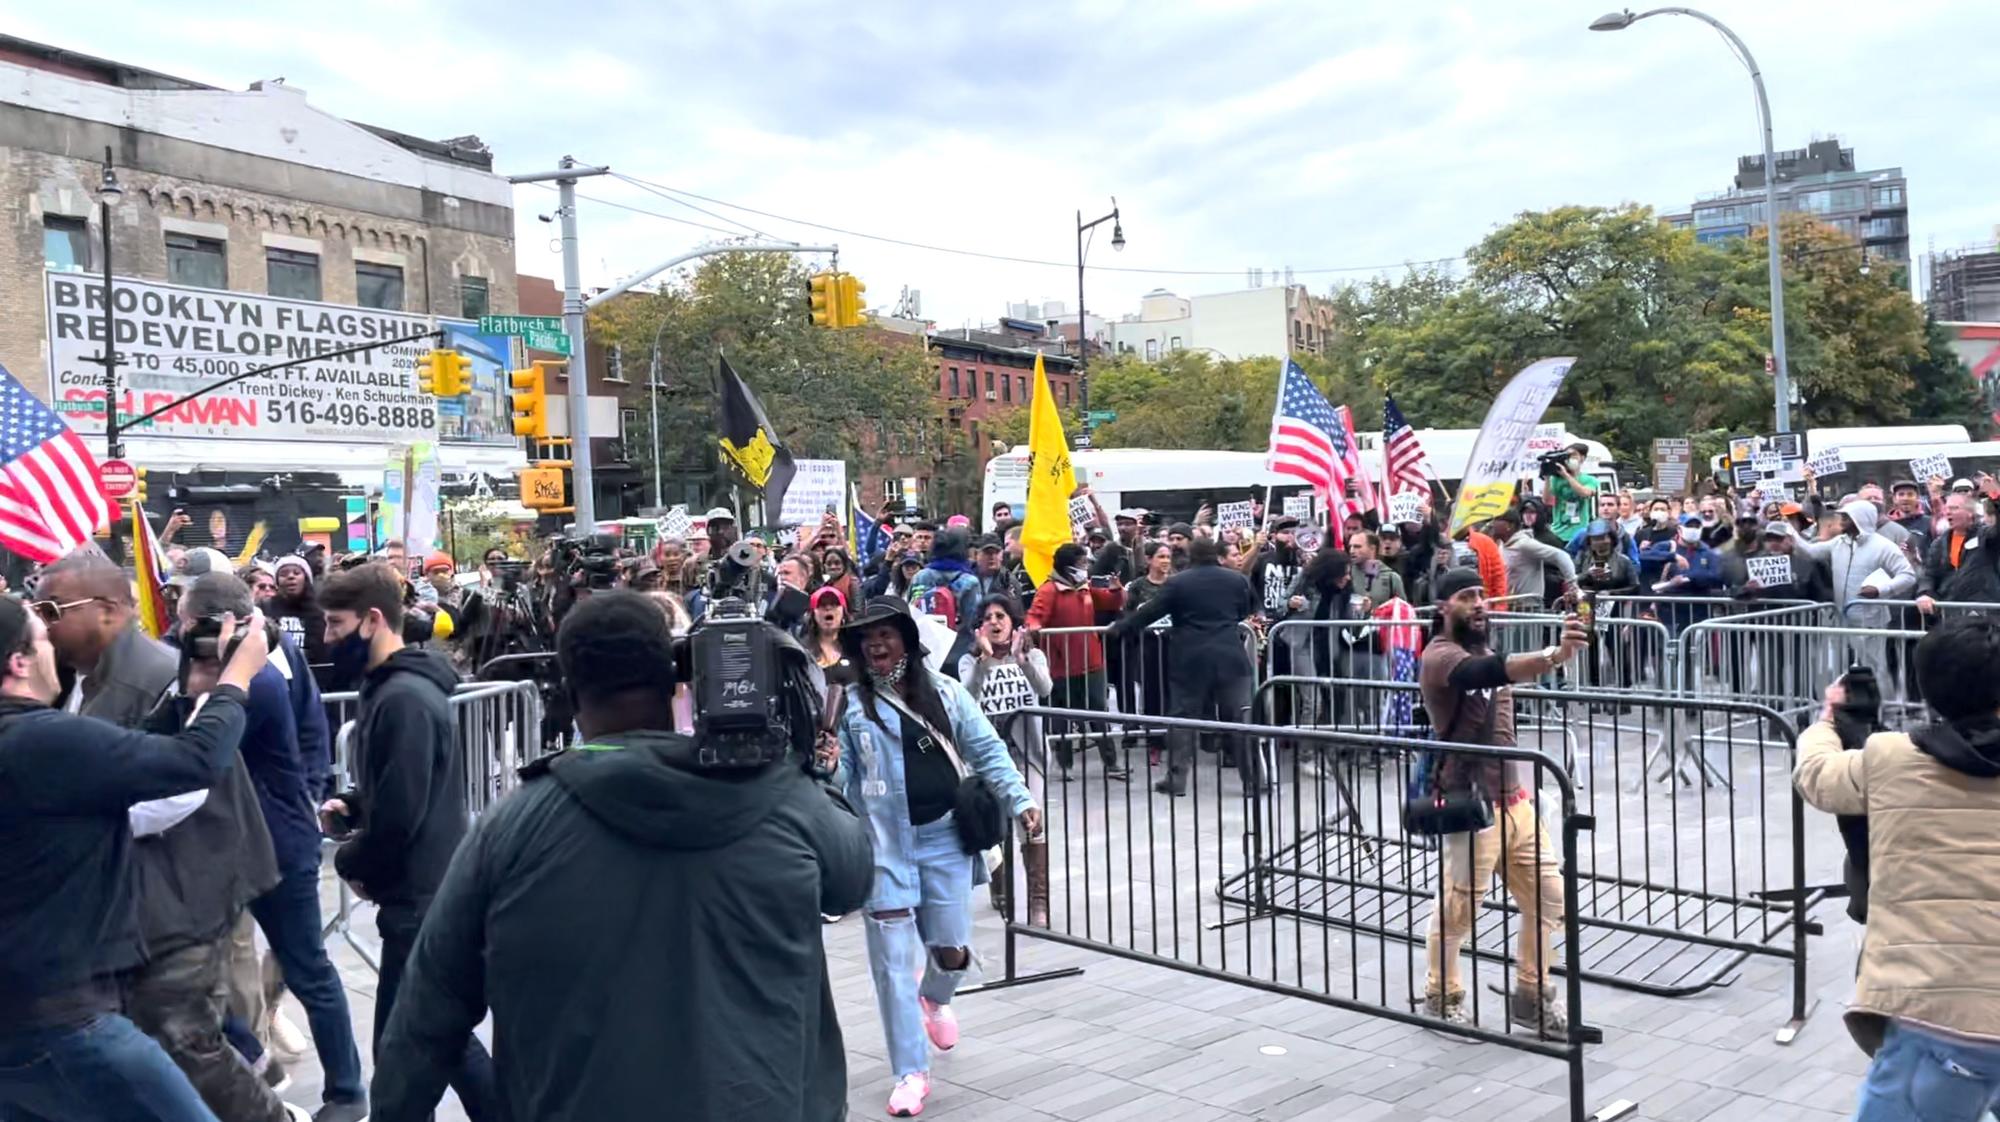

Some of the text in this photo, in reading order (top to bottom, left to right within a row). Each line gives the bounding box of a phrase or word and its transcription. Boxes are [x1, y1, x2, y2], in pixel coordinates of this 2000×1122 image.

[54, 281, 428, 342] BROOKLYN FLAGSHIP
[481, 316, 545, 333] Flatbush
[56, 313, 378, 366] REDEVELOPMENT
[132, 352, 160, 370] TO
[172, 356, 239, 377] 45,000
[245, 362, 278, 380] SQ.
[284, 365, 309, 382] FT.
[315, 368, 410, 388] AVAILABLE
[60, 371, 123, 386] Contat
[237, 381, 274, 396] Trent
[279, 384, 323, 402] Dickey
[336, 388, 359, 401] Ken
[363, 389, 434, 405] Schuckman
[267, 400, 435, 429] 516-496-8888
[1911, 452, 1946, 468] STAND
[1918, 461, 1948, 475] WITH
[1219, 503, 1250, 513] STAND
[1221, 512, 1251, 521] WITH
[1749, 557, 1788, 568] STAND
[1751, 566, 1787, 576] WITH
[1761, 575, 1790, 584] YRIE
[982, 679, 1029, 698] WITH
[980, 694, 1034, 714] KYRIE
